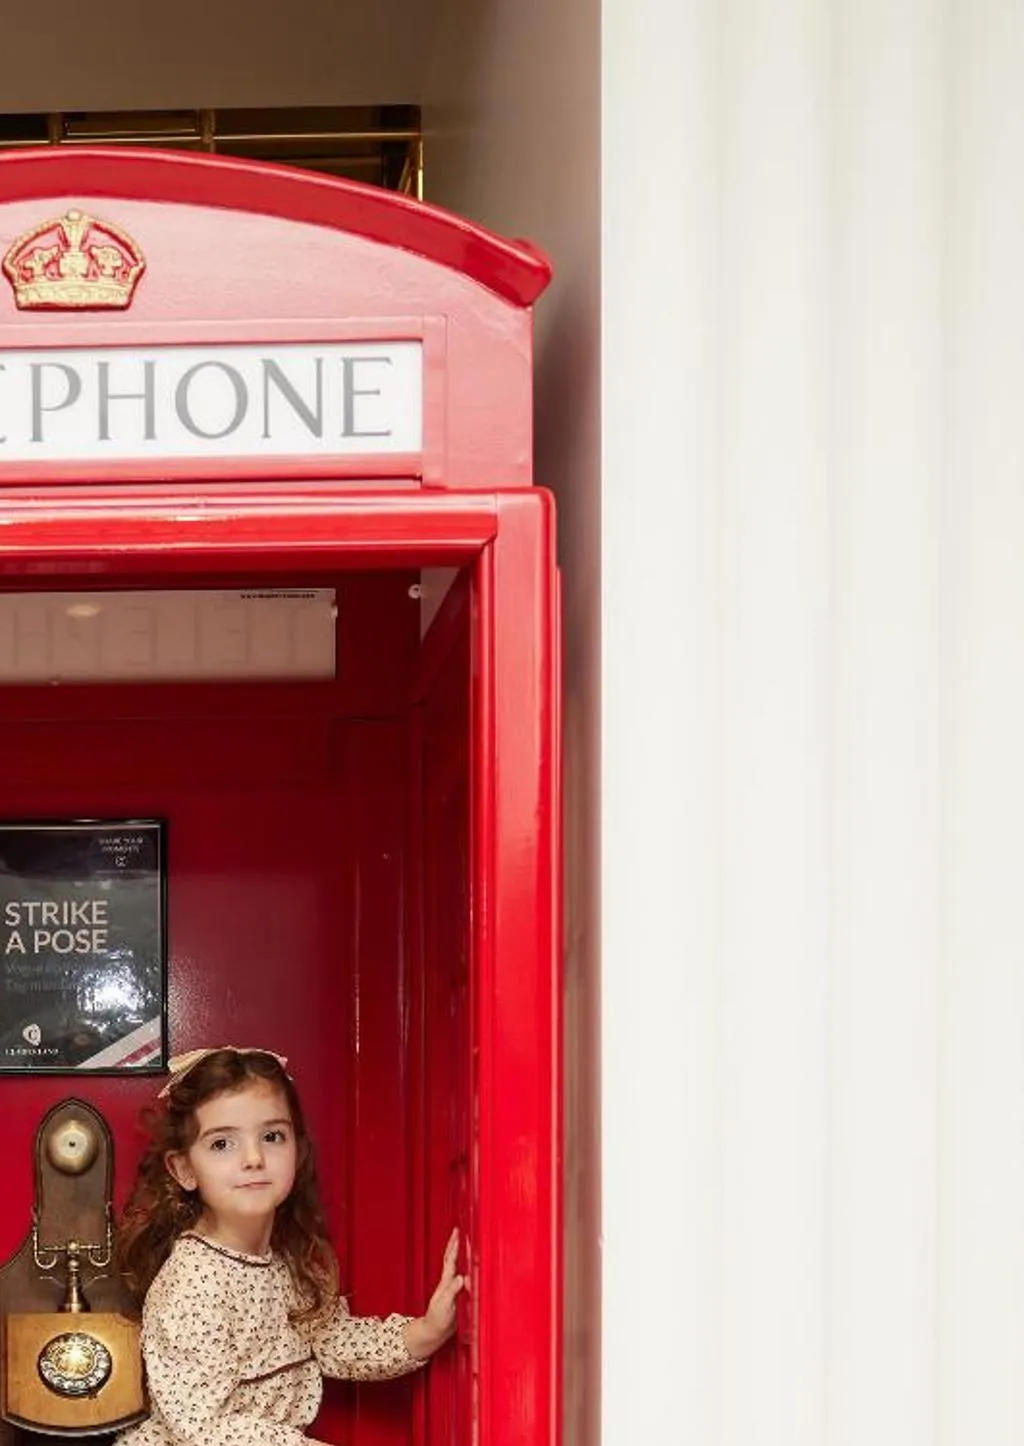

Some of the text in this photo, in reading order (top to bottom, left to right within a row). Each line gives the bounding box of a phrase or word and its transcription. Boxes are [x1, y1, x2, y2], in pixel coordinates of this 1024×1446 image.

[5, 900, 108, 927] STRIKE
[5, 929, 108, 955] A POSE
